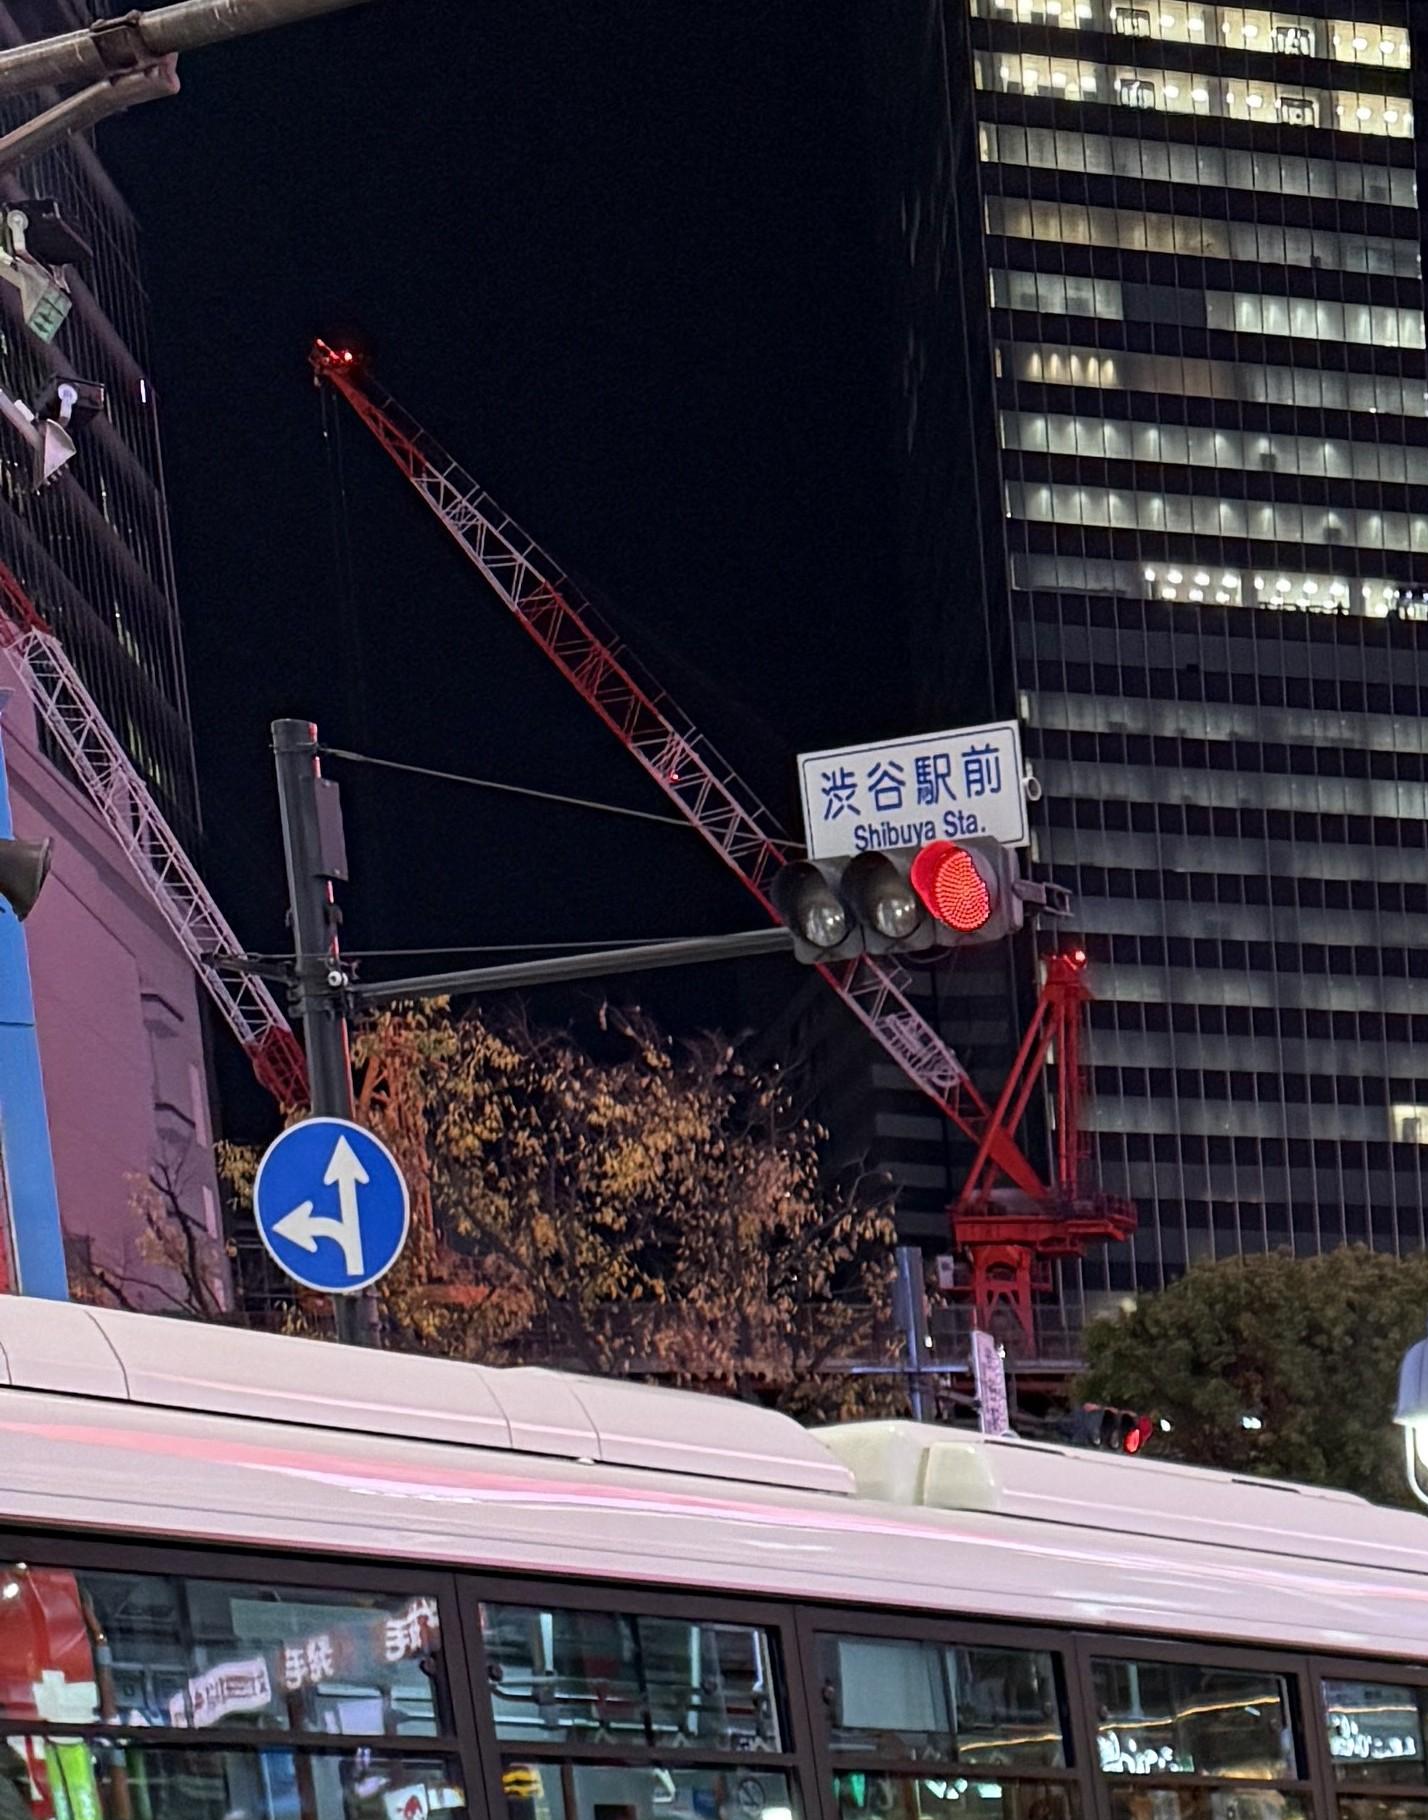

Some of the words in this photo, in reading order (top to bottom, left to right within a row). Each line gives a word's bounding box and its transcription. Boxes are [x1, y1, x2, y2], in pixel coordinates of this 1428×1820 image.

[821, 743, 1002, 821] 渋谷駅前
[854, 819, 936, 851] Shibuya
[943, 810, 986, 837] Sta.
